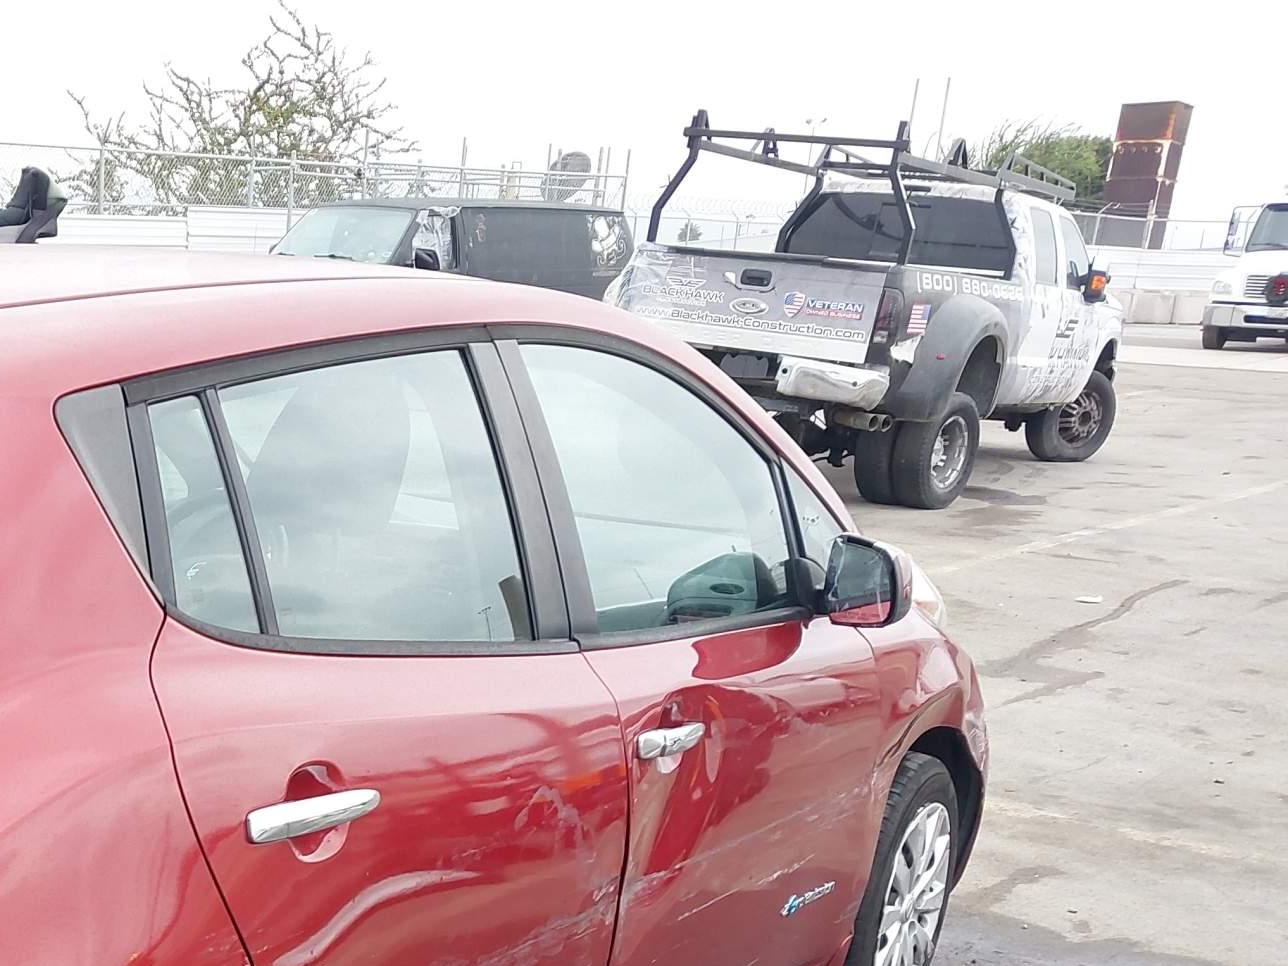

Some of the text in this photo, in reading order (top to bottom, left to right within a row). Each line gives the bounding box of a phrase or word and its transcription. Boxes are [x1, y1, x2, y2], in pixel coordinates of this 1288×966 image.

[917, 271, 958, 296] (800)
[642, 285, 725, 303] BLACKHAWK
[808, 299, 864, 313] VETERAN
